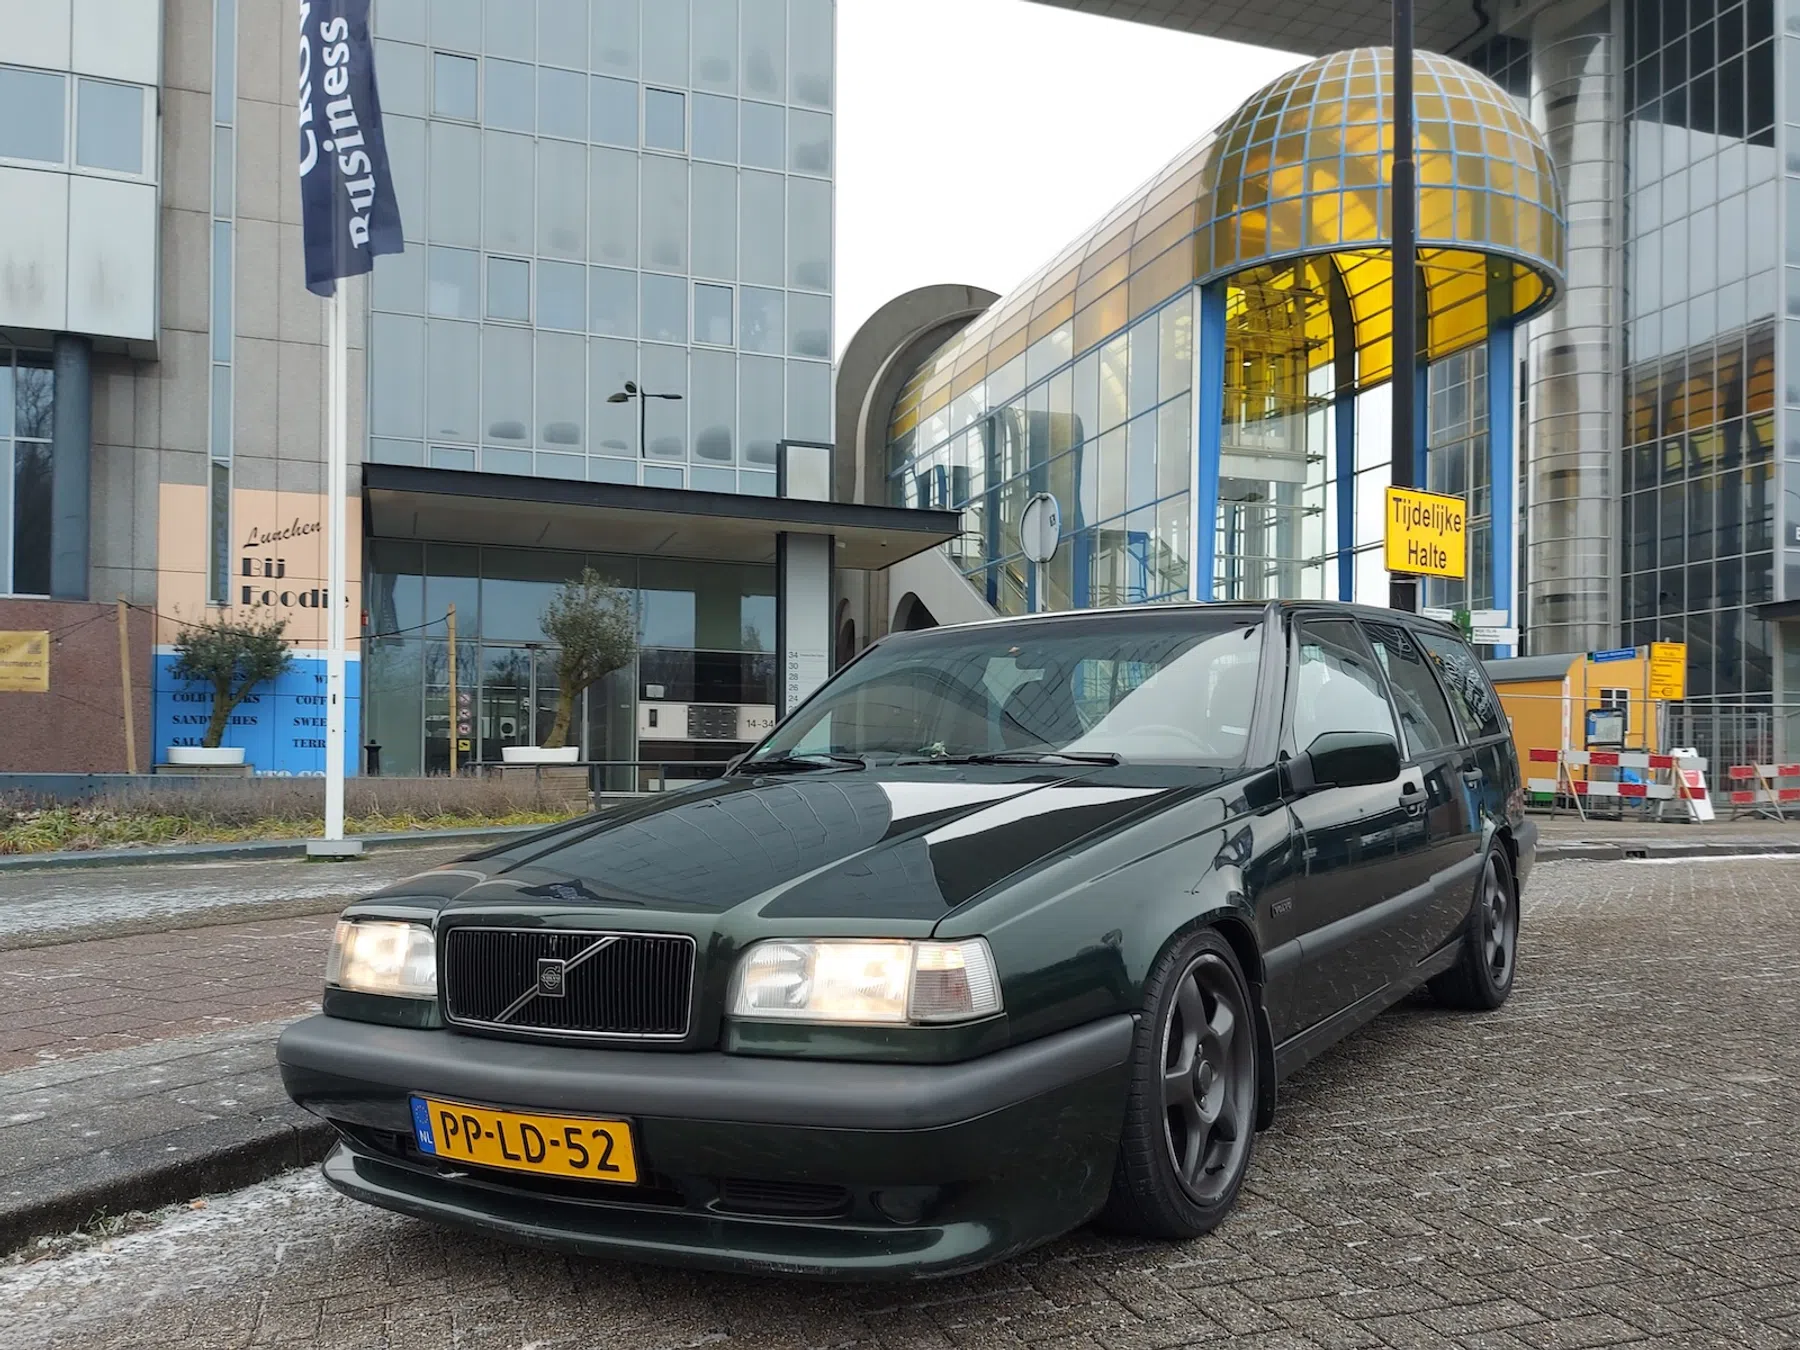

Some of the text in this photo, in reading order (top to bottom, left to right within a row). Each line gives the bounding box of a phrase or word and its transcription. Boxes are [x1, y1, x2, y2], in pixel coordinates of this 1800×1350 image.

[320, 16, 376, 249] Business
[1393, 497, 1462, 536] Tijdelijke
[242, 517, 321, 549] Lunchen
[1408, 539, 1447, 569] Halte
[242, 557, 285, 579] Bij
[242, 585, 349, 608] Foodi
[788, 651, 798, 659] 34
[788, 662, 798, 670] 30
[295, 695, 327, 705] COFF
[788, 694, 798, 702] 24
[293, 716, 328, 727] SWEE
[746, 719, 774, 728] 14-34
[292, 739, 326, 748] TERR
[419, 1129, 433, 1144] NL
[440, 1110, 621, 1173] PP-LD-52
